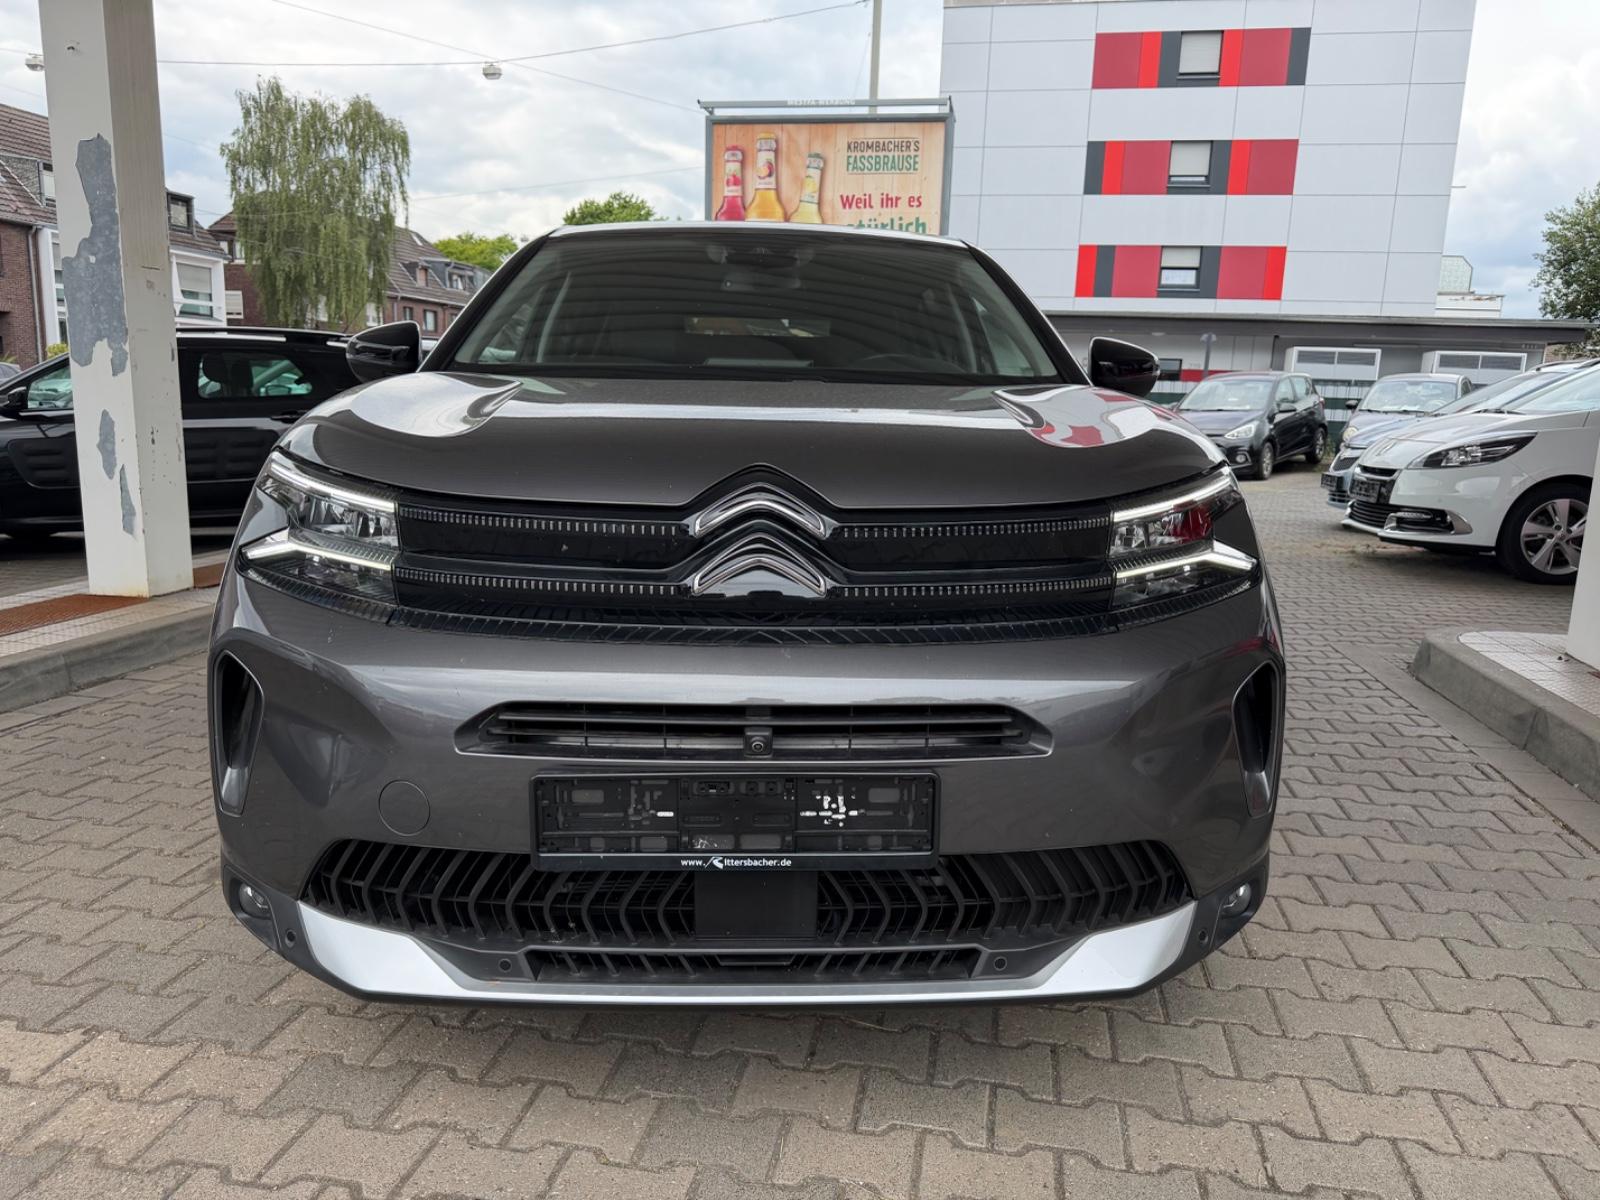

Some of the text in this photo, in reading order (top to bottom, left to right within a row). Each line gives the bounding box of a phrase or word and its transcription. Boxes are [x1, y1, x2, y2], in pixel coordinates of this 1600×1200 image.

[846, 154, 919, 172] FASSBRAUSE
[840, 192, 922, 209] Weil ihr es
